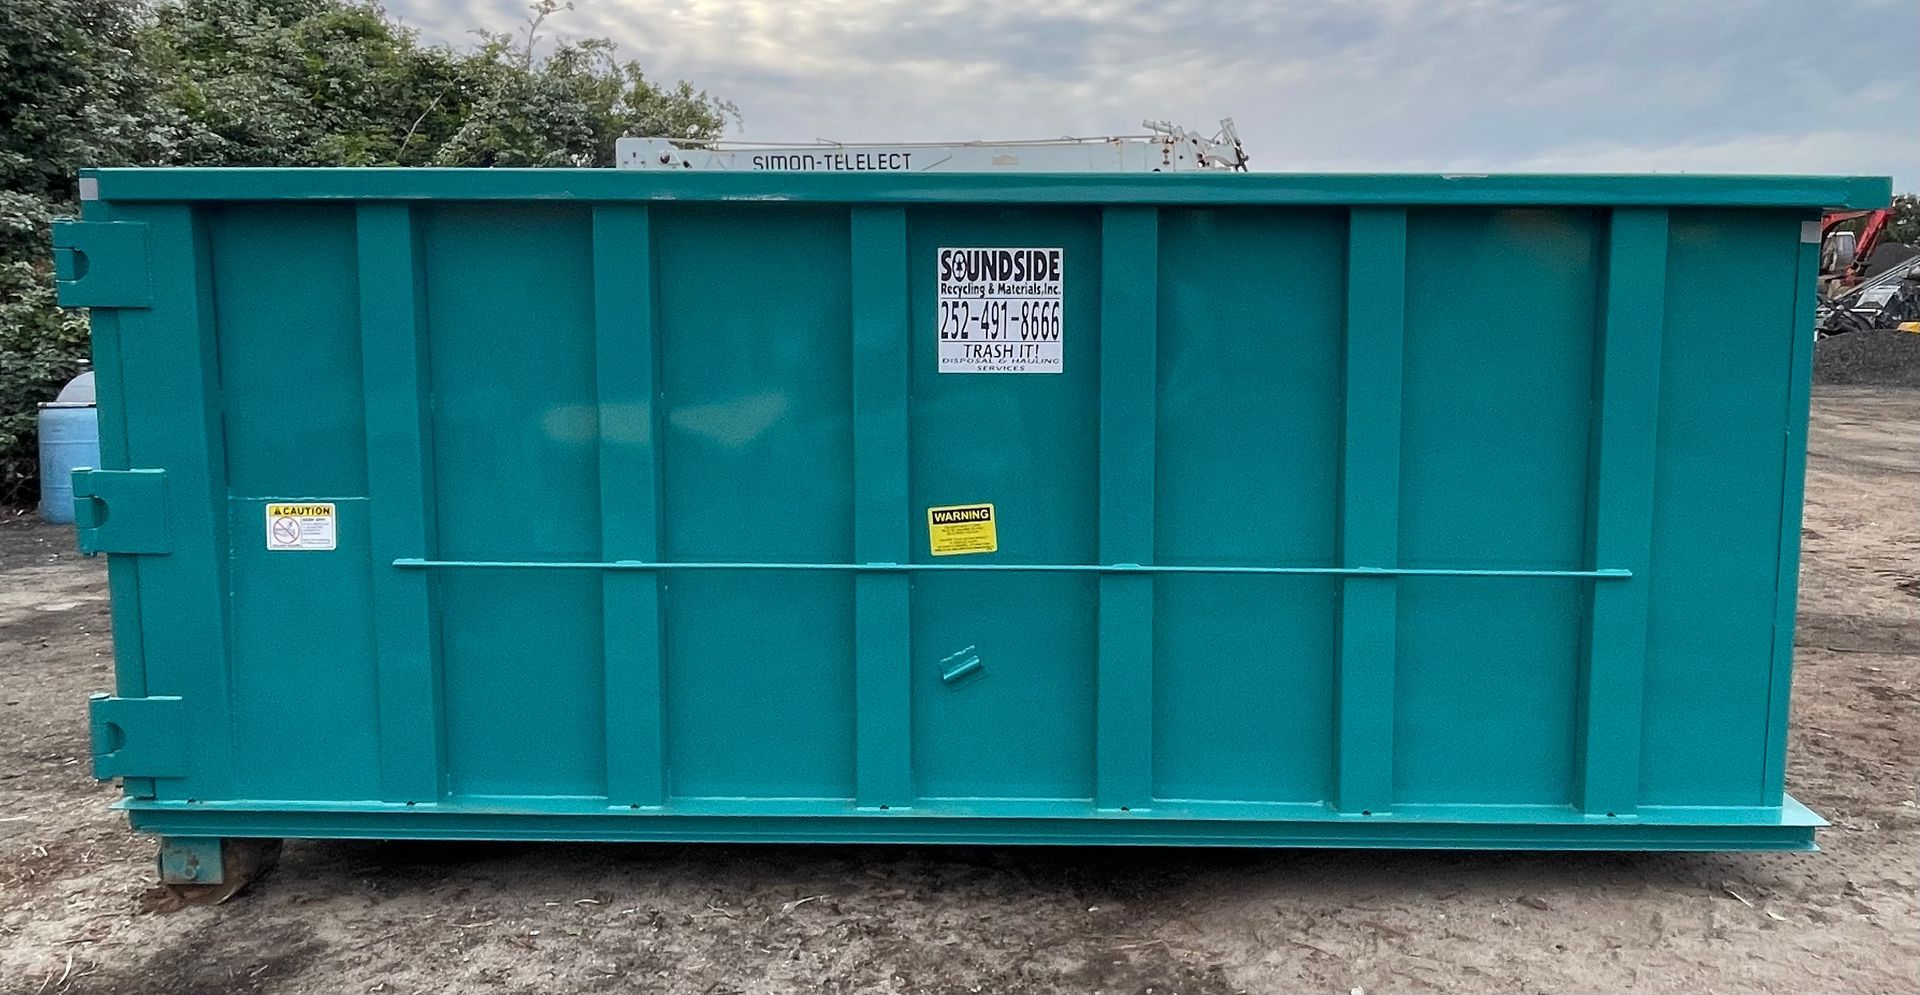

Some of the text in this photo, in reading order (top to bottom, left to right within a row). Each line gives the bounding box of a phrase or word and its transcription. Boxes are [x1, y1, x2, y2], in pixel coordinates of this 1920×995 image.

[753, 153, 912, 170] SIMON-TELELECT
[941, 250, 1060, 282] SOUNDSIDE
[941, 283, 985, 299] Recycling
[988, 283, 995, 295] &
[941, 301, 1060, 340] 252-491-8666
[963, 344, 1039, 359] TRASH IT!
[283, 507, 330, 515] CAUTION
[934, 509, 989, 522] WARNING
